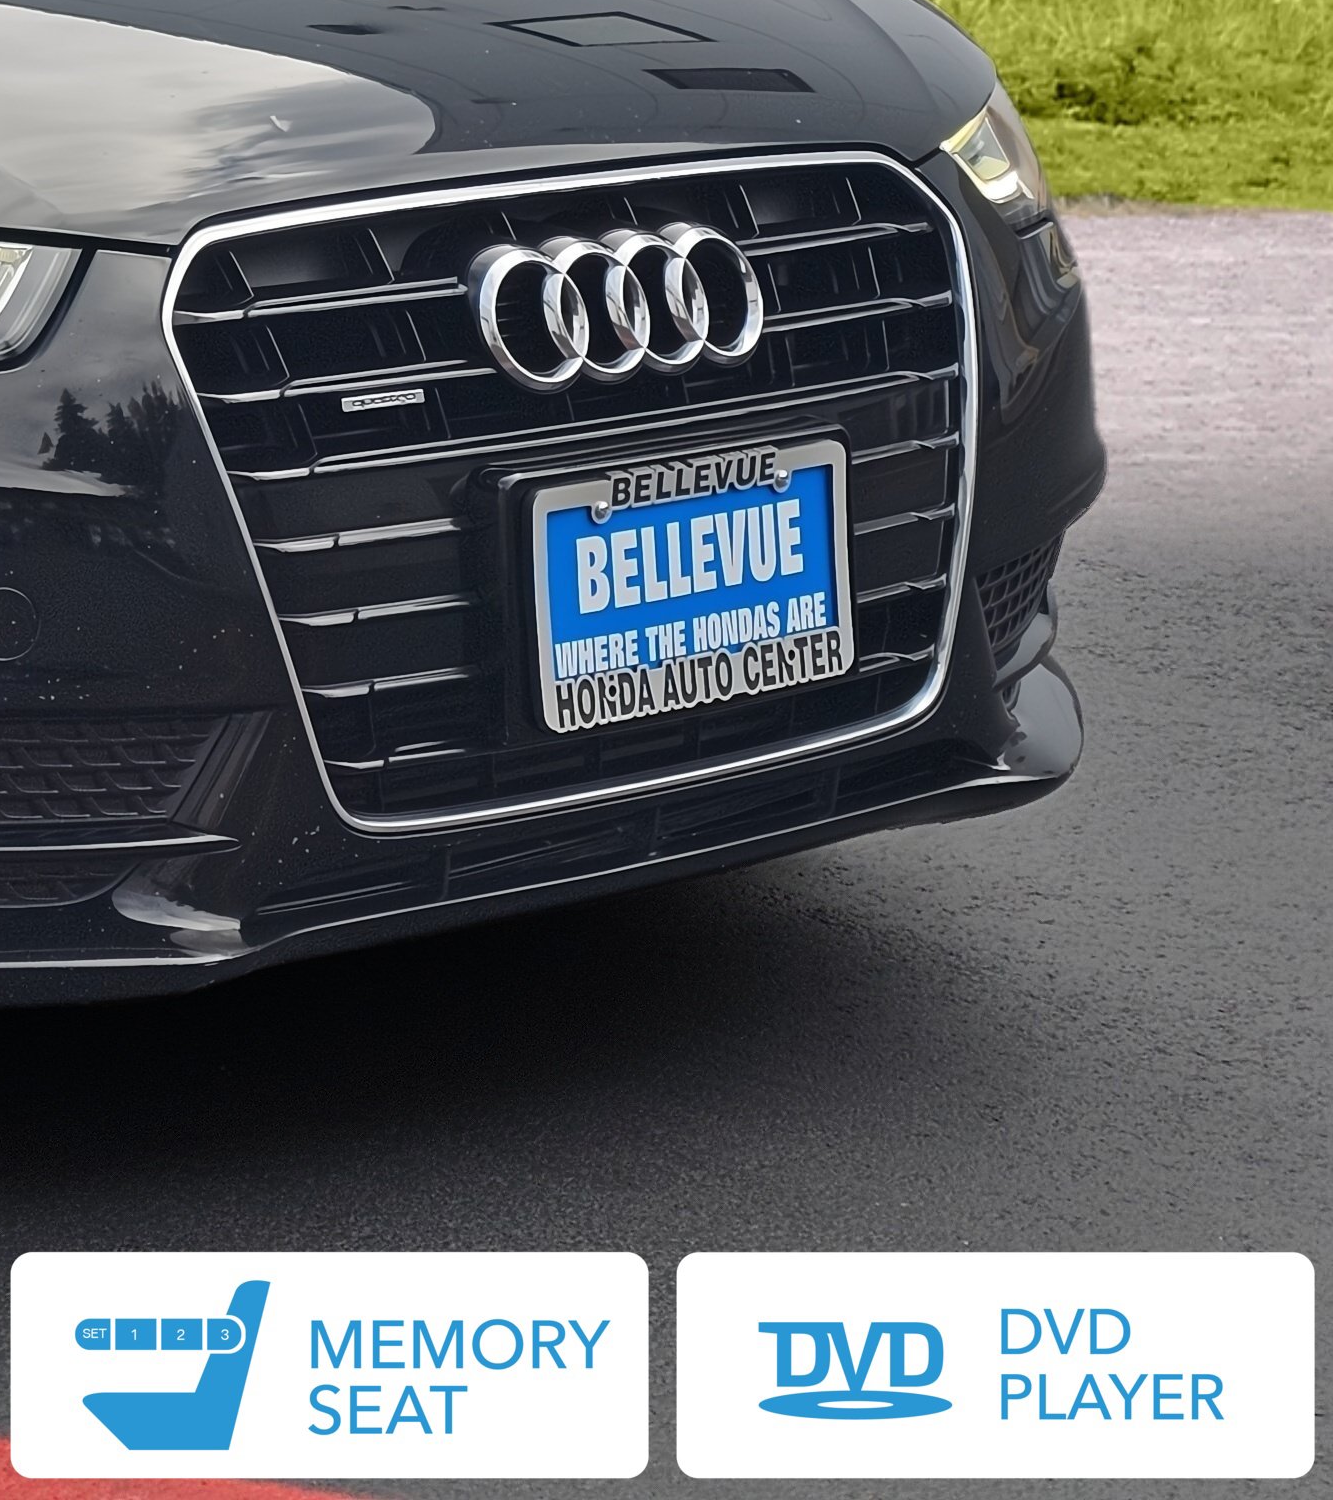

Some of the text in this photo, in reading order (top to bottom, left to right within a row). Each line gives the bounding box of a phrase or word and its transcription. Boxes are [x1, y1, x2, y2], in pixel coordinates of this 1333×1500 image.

[611, 451, 777, 508] BELLEVUE
[575, 498, 804, 615] BELLEVUE
[555, 591, 827, 679] WHERE THE HONDAS ARE
[555, 630, 843, 729] HONDA AUTO CENTER
